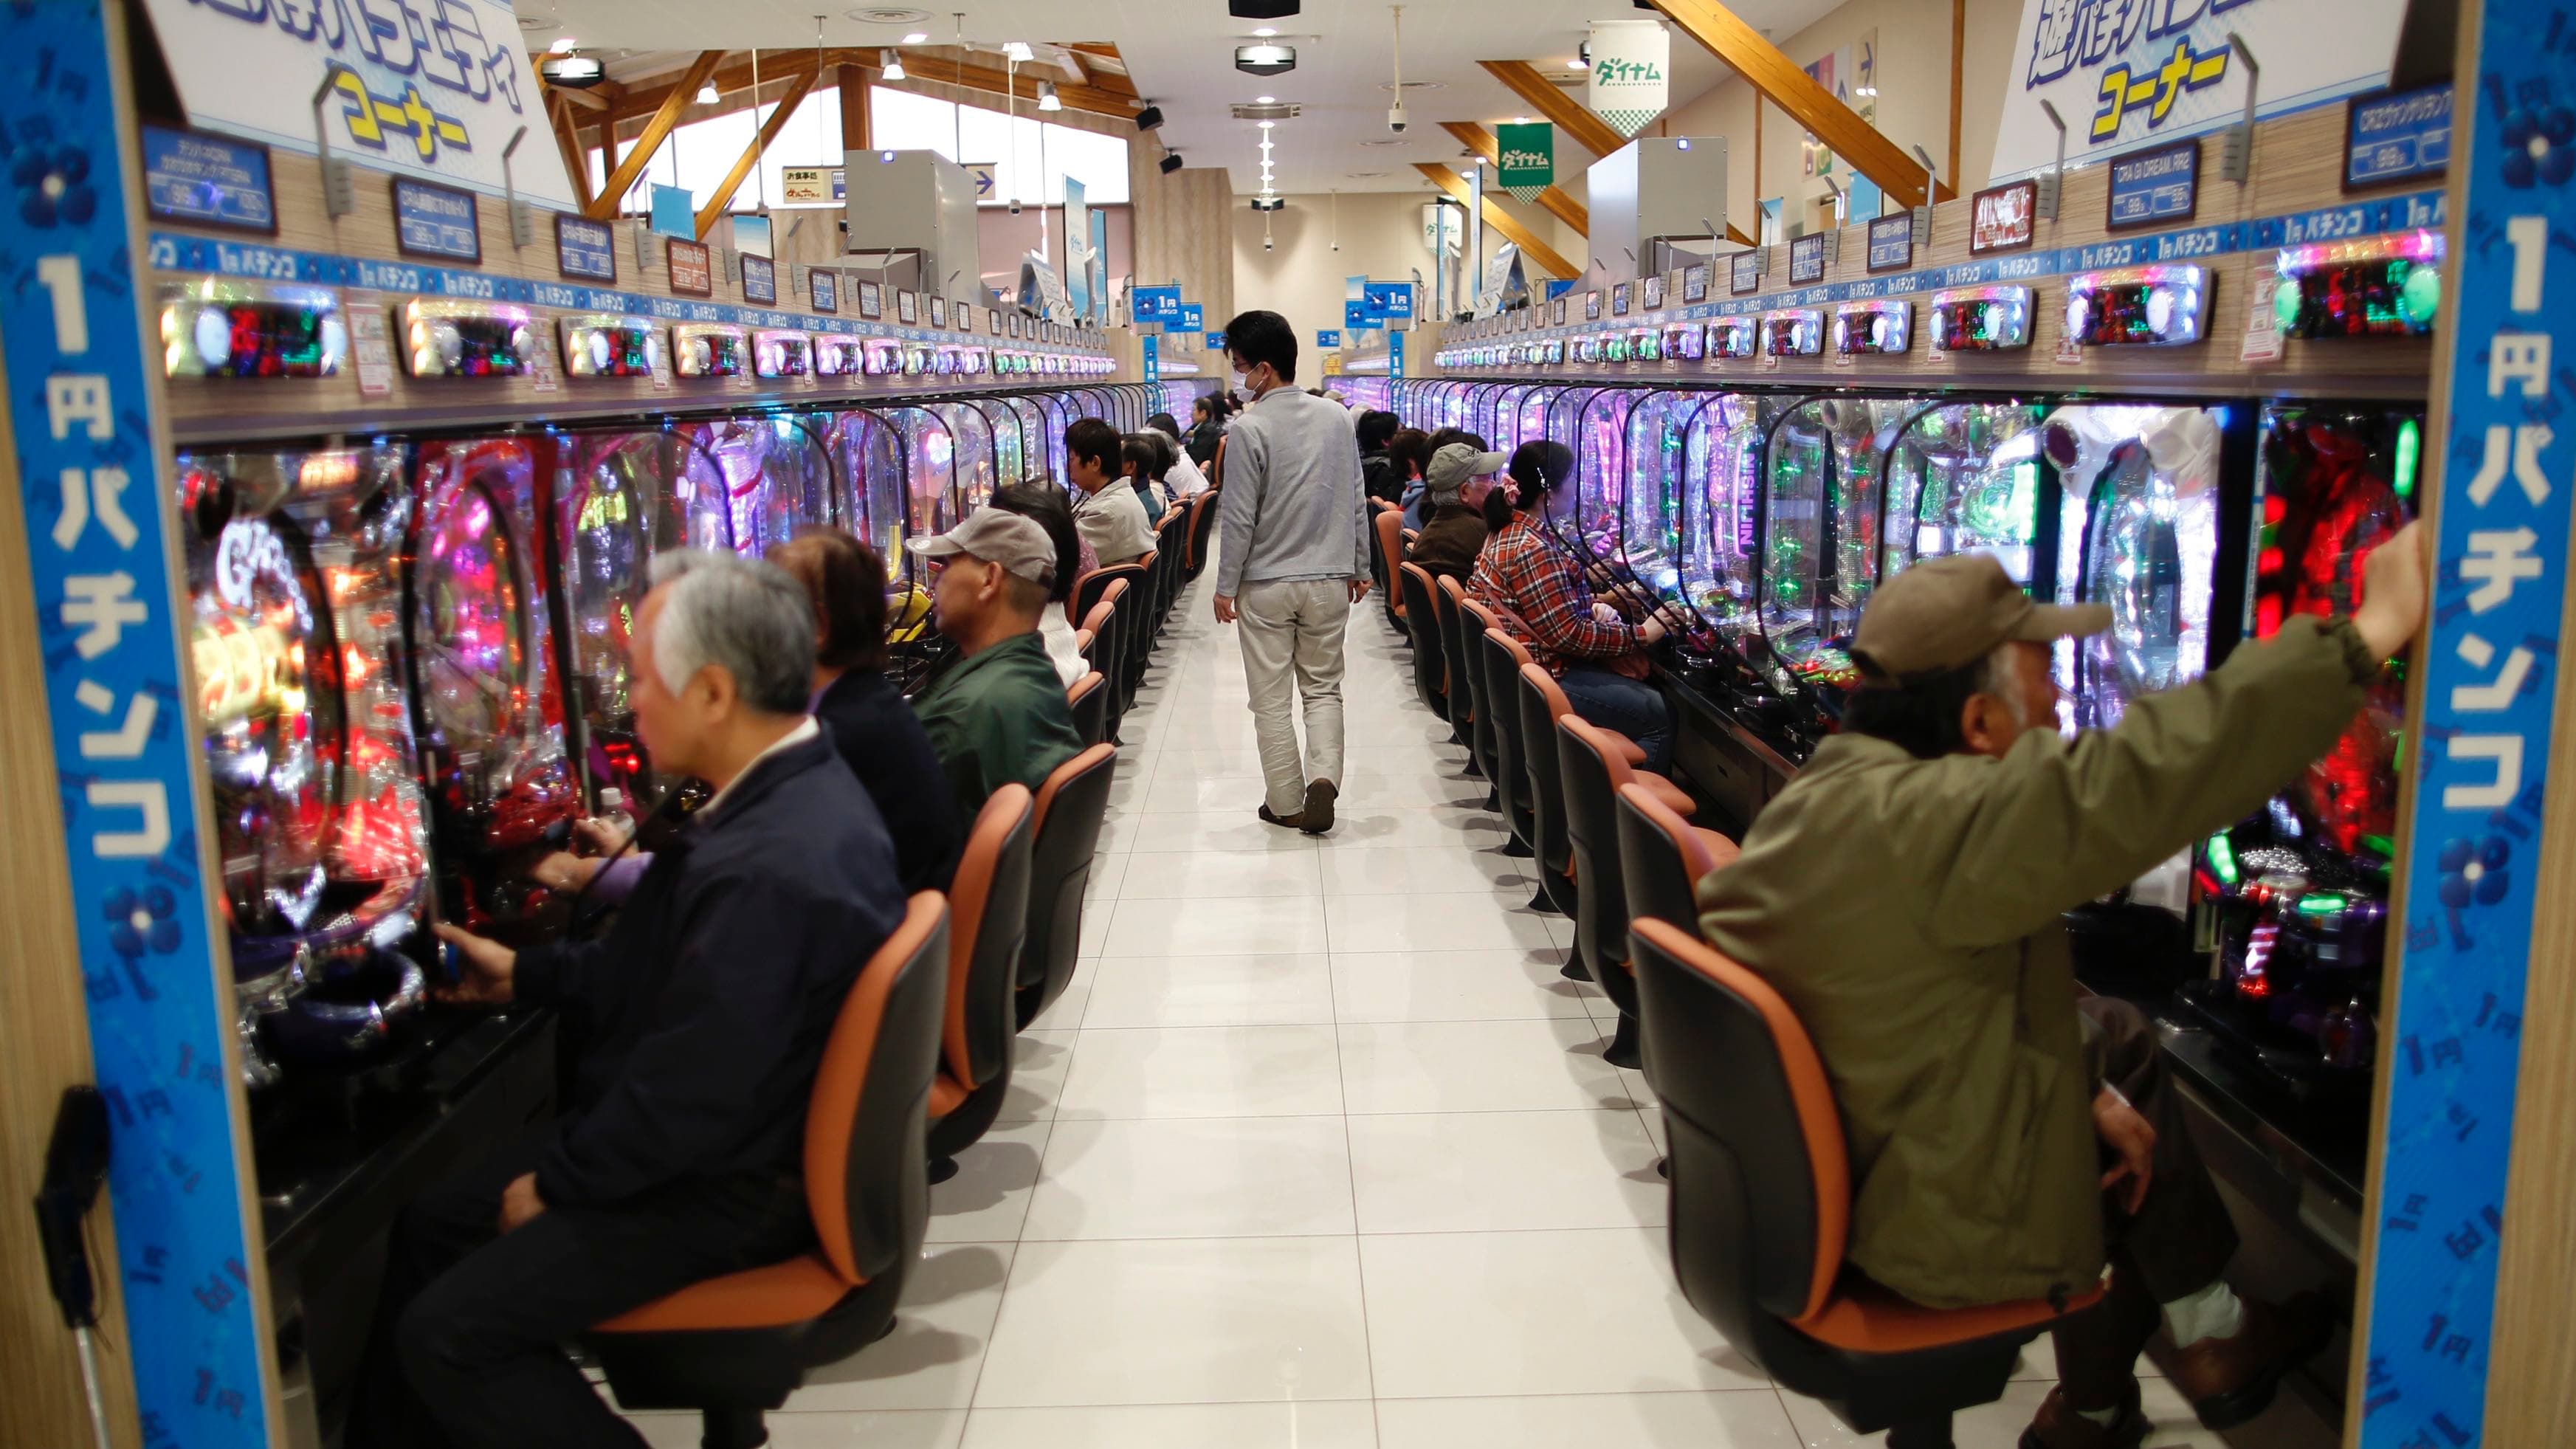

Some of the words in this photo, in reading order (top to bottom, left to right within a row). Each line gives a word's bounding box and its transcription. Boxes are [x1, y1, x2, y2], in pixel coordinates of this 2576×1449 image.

[1596, 58, 1661, 86] ダイナム
[2090, 36, 2229, 143] コーナー
[328, 62, 470, 162] コーナー
[1501, 150, 1549, 171] ダイナム
[2284, 210, 2363, 244] 1円パチンコ
[2081, 244, 2132, 269] 1円パチンコ
[2159, 231, 2219, 260] 1円パチンコ
[216, 244, 297, 278] 1円パチンコ
[1999, 257, 2039, 279] 1円パチンコ
[359, 261, 419, 290] 1円パチンコ
[443, 271, 493, 297] 1円パチンコ
[1887, 276, 1915, 294] 1円パチンコ
[1946, 266, 1980, 286] 1円パチンコ
[534, 284, 574, 306] 1円パチンコ
[589, 292, 624, 312] 1円パチンコ
[1158, 295, 1176, 308] 1円
[1389, 292, 1407, 304] 1円
[1777, 295, 1797, 308] 1円パチンコ
[1806, 289, 1828, 300] 1円パチンコ
[1850, 283, 1875, 299] 1円パチンコ
[653, 299, 681, 317] 1円パチンコ
[692, 304, 717, 320] 1円パチンコ
[1184, 311, 1199, 321] 1円
[2440, 215, 2555, 809] 1円パチンコ
[37, 255, 171, 857] 1円パチンコ
